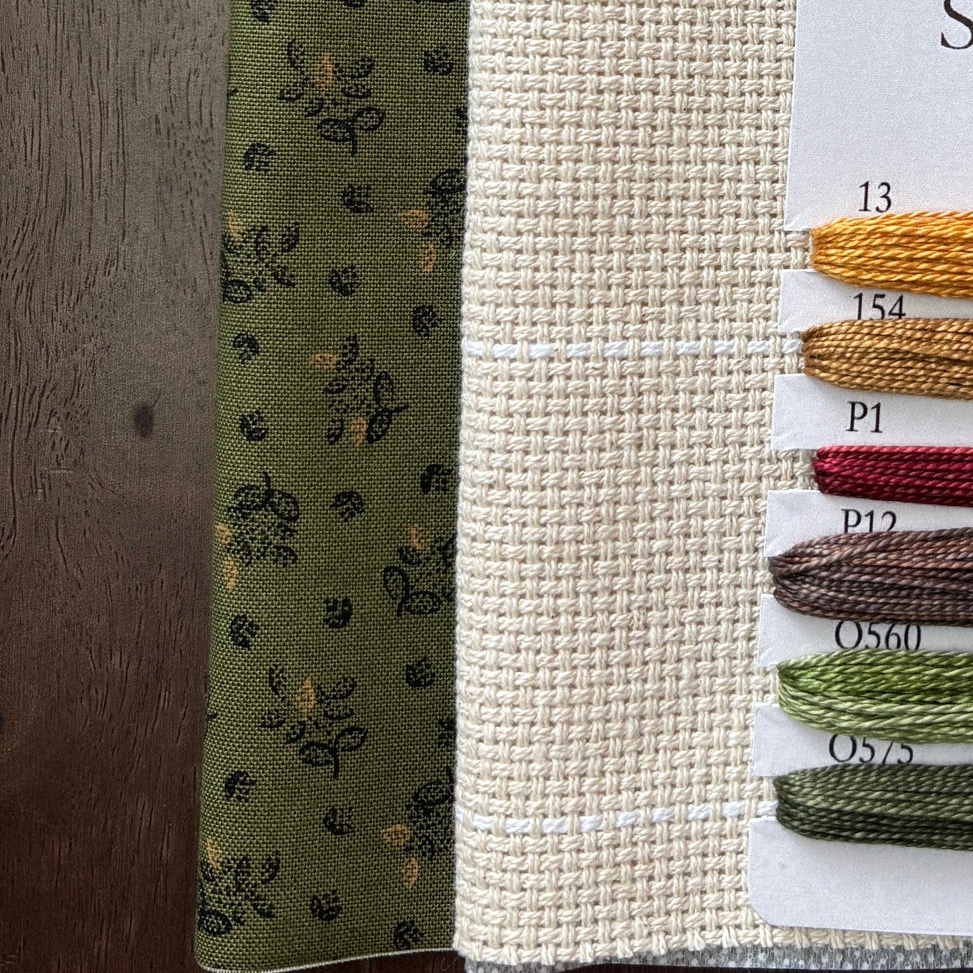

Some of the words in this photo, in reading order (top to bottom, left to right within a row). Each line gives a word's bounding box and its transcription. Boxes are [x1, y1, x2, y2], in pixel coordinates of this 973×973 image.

[858, 180, 893, 213] 13
[852, 292, 907, 320] 154
[845, 400, 884, 434] P1
[840, 508, 897, 533] P12
